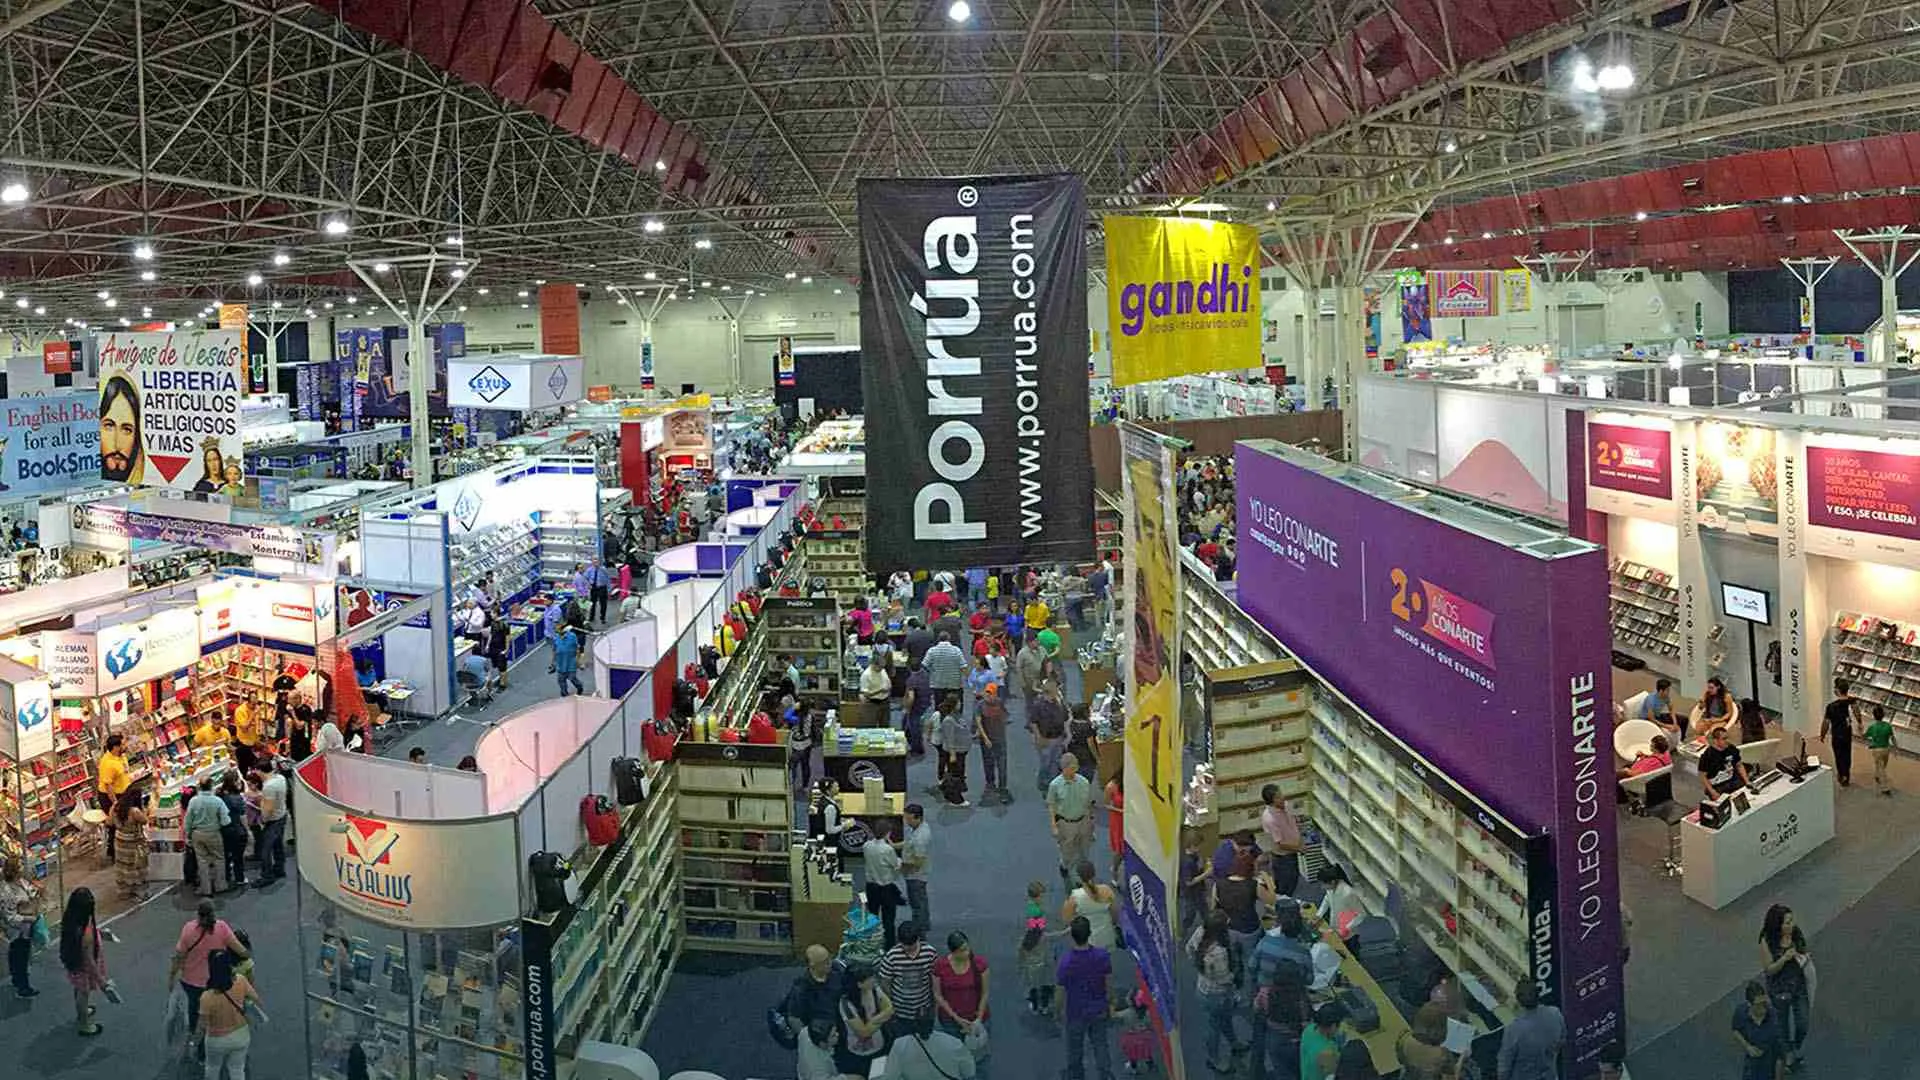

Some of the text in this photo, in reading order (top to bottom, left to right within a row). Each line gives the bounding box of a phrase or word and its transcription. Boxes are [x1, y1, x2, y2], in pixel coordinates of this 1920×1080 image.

[1121, 263, 1252, 336] gandhi
[101, 329, 239, 372] Amigos de Jesús
[469, 376, 511, 393] LEXUS
[1008, 214, 1045, 539] www.porrua.com
[8, 404, 69, 431] English
[144, 414, 236, 435] RELIGIOSOS
[24, 430, 48, 450] for
[51, 426, 71, 447] all
[145, 431, 194, 453] Y MÁS
[1826, 504, 1833, 514] Y
[1834, 505, 1855, 518] ESO,
[1871, 510, 1917, 525] CELEBRA!
[1249, 496, 1263, 522] YO
[1263, 503, 1283, 534] LEO
[1284, 516, 1341, 568] CONARTE
[1431, 612, 1484, 654] CONARTE
[1454, 662, 1495, 692] EVENTOS!
[1571, 672, 1601, 941] YO LEO CONARTE
